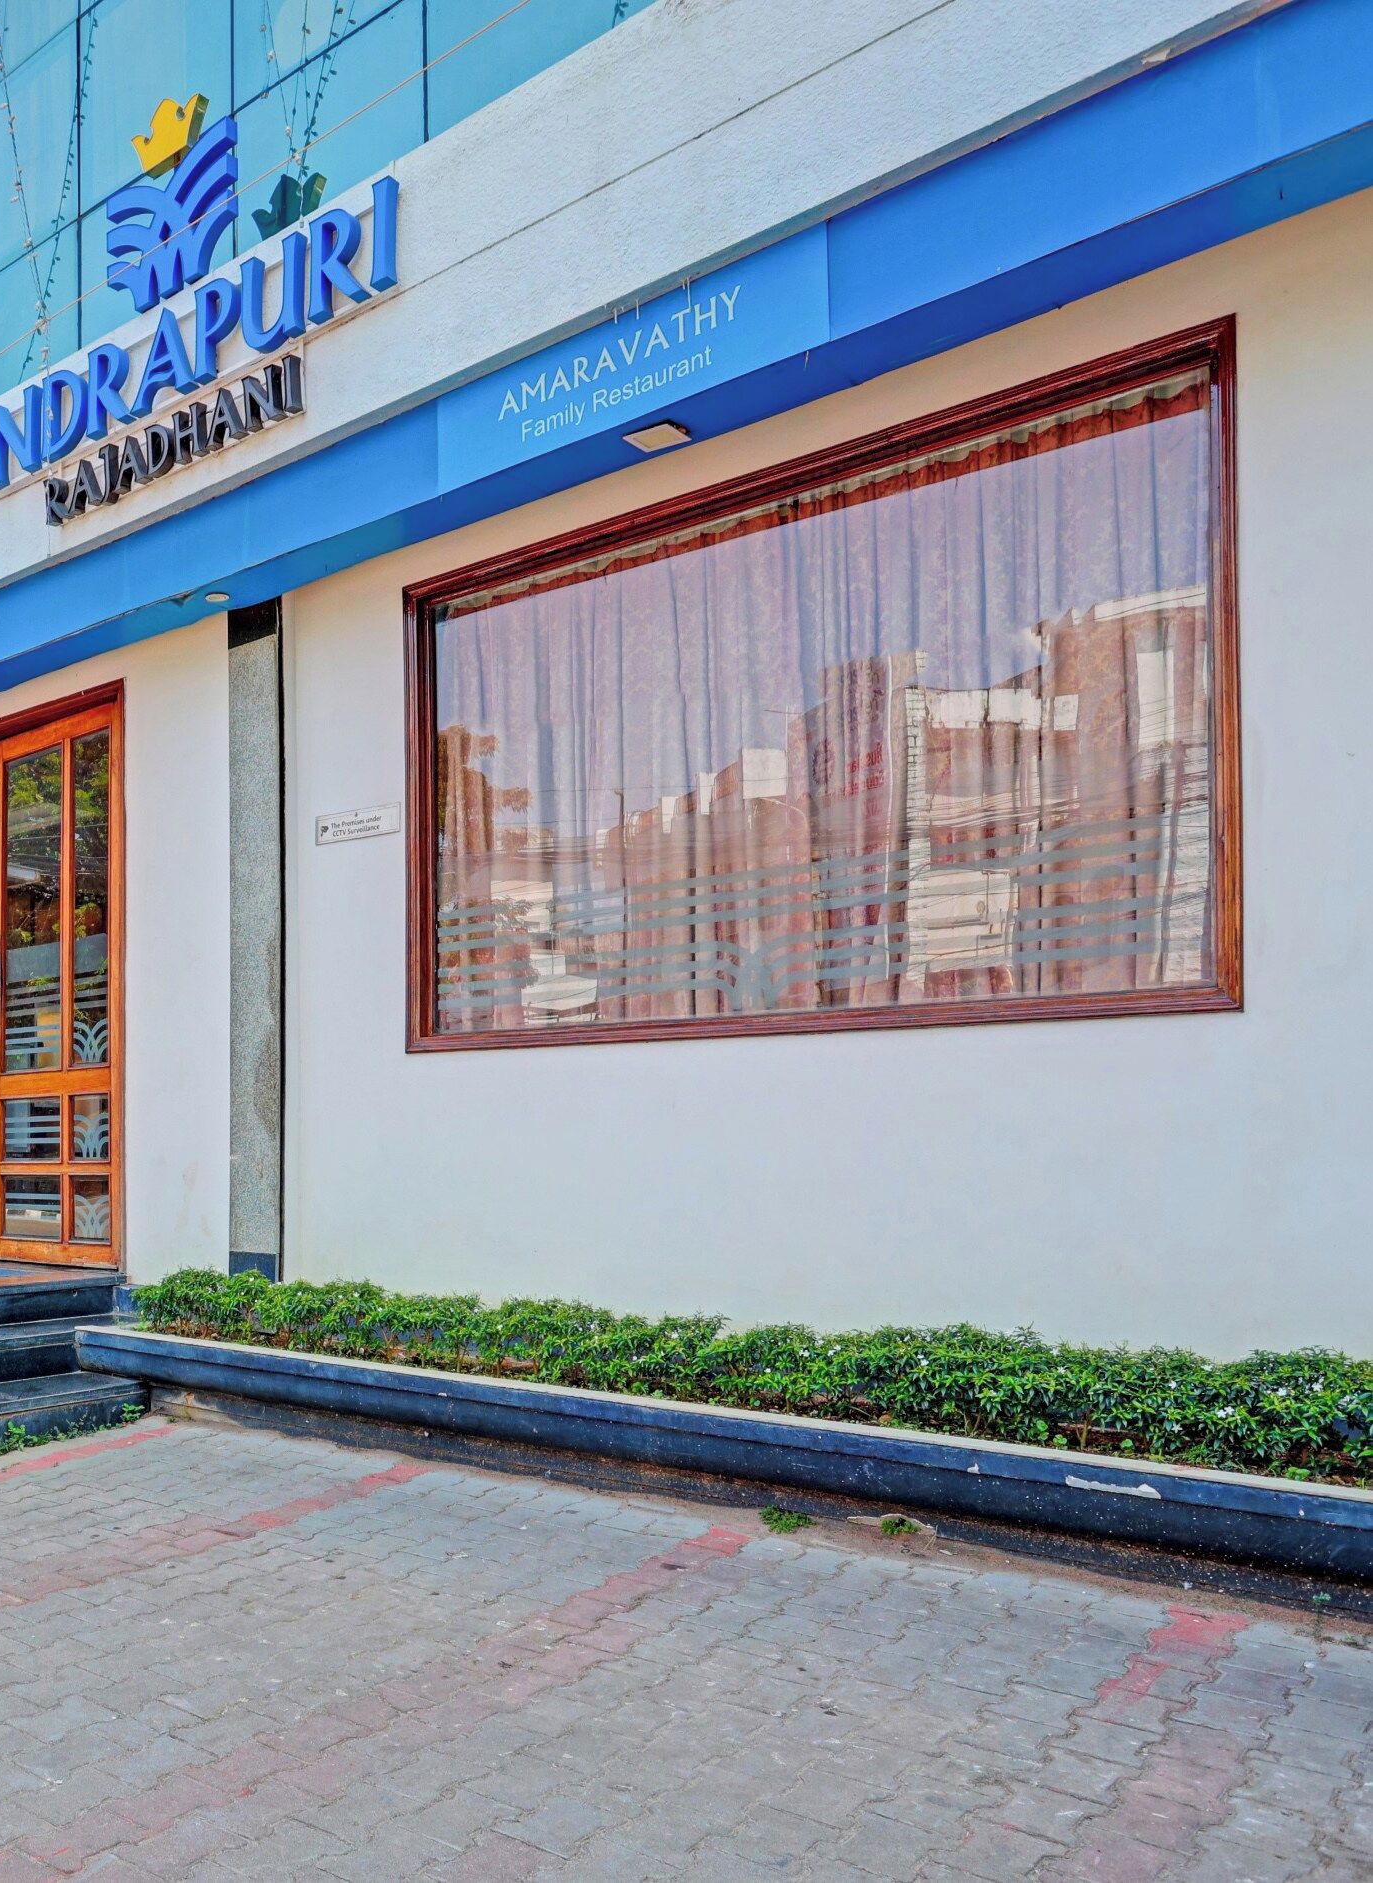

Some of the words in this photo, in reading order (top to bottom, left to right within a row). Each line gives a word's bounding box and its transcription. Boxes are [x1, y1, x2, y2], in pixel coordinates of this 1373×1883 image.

[498, 285, 741, 422] AMARAVATHY
[521, 400, 586, 442] Family
[592, 344, 712, 413] Restaurant
[43, 355, 303, 526] RAJADHANI
[332, 829, 346, 837] CCTV
[347, 824, 380, 835] Surveillance
[341, 818, 365, 827] Premises
[366, 815, 381, 823] under
